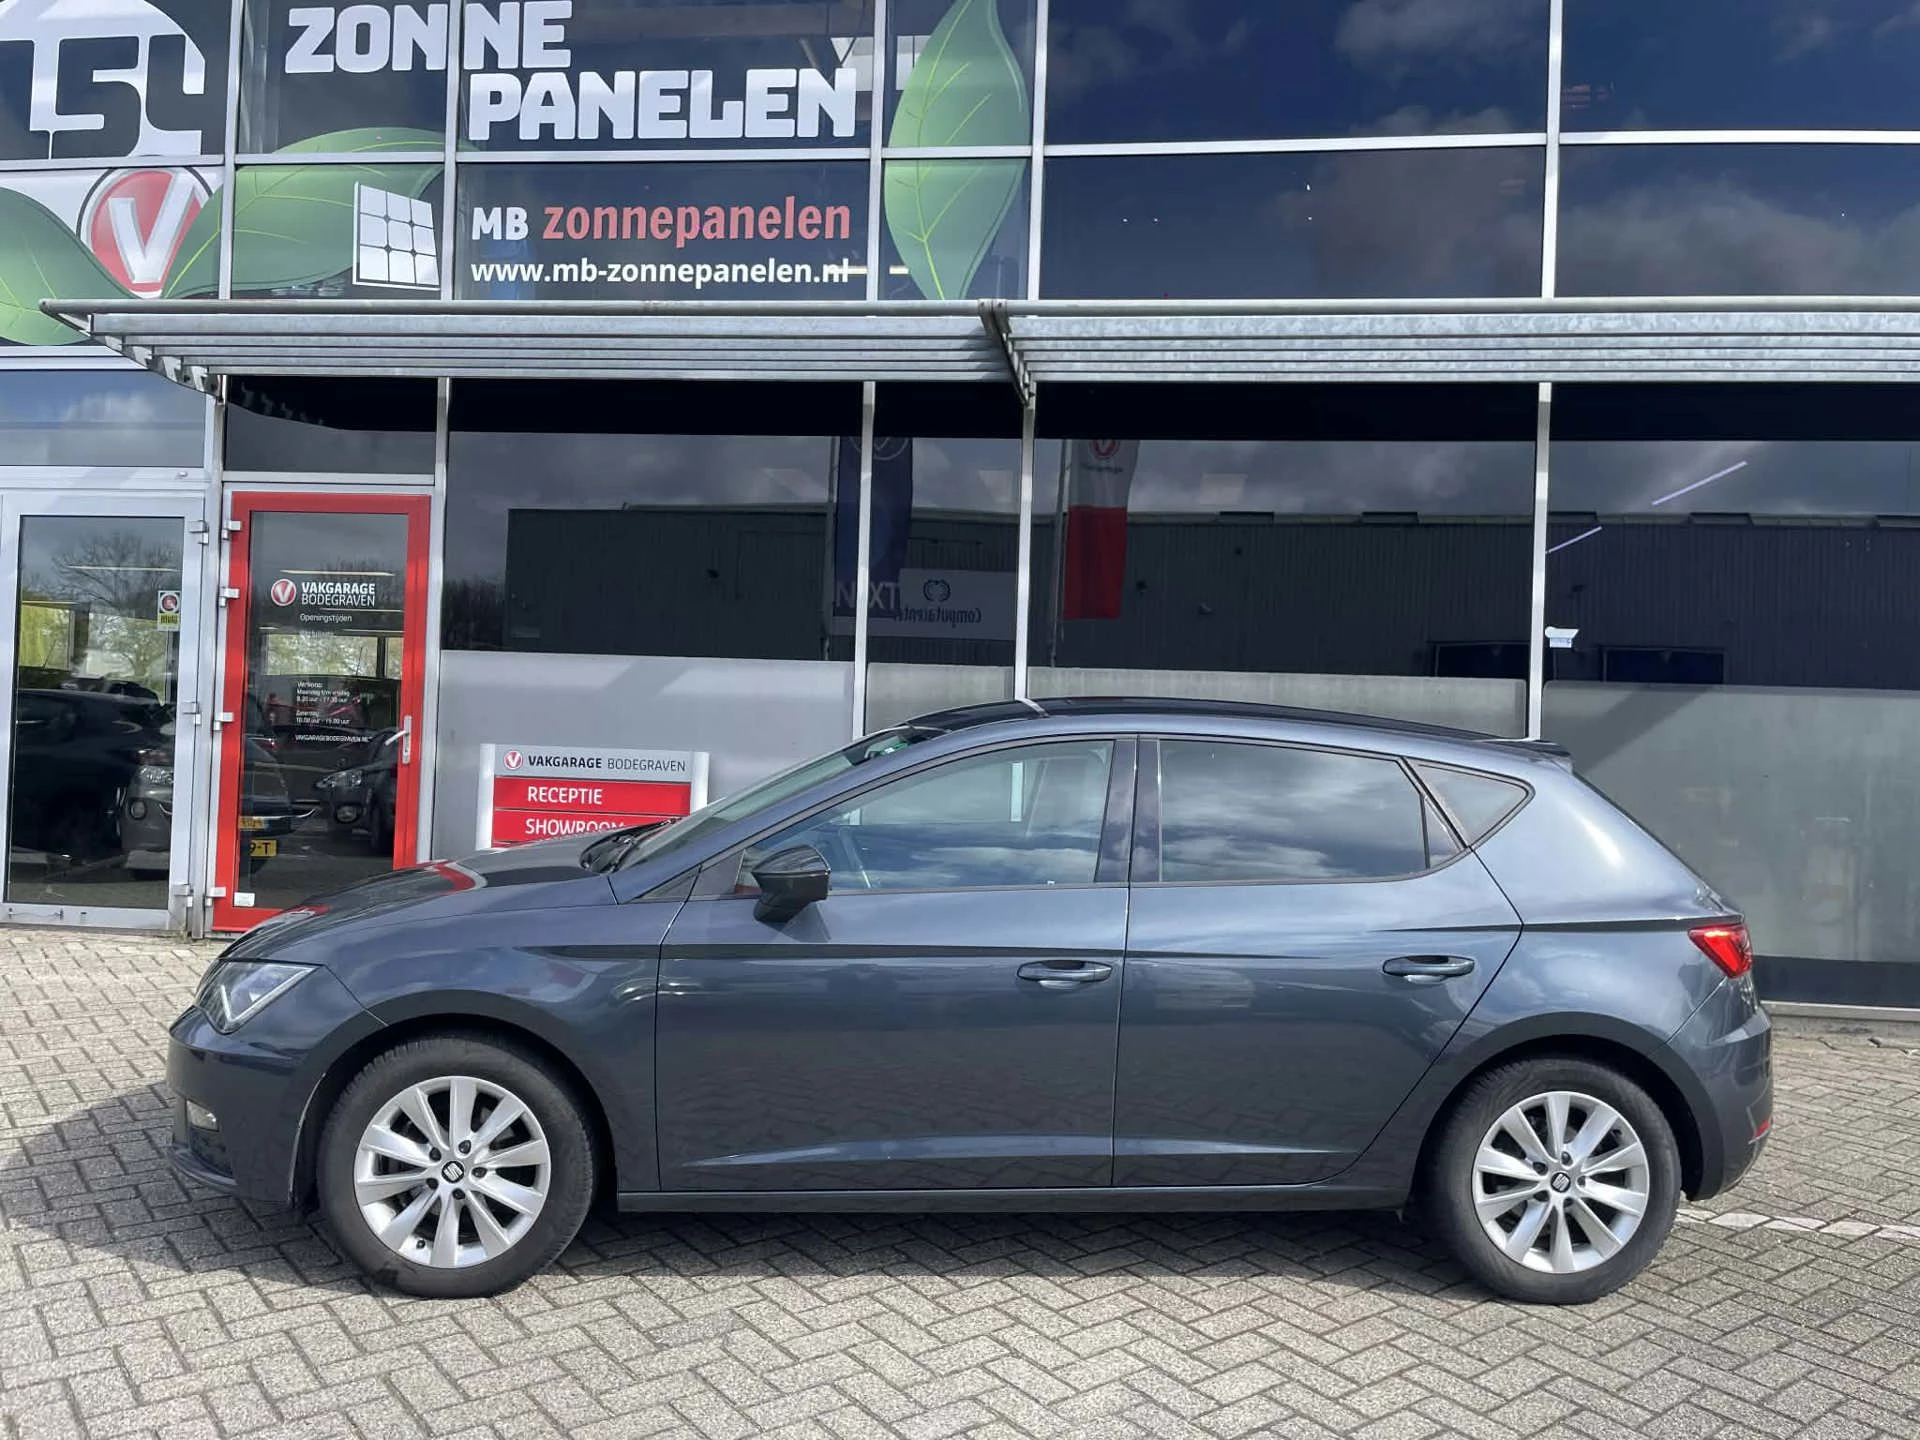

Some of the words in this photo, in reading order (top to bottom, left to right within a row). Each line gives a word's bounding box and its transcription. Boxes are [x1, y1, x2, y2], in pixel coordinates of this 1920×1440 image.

[285, 0, 572, 74] ZONNE
[468, 68, 857, 141] PANELEN
[471, 206, 529, 241] MB
[543, 196, 850, 248] zonnepanelen
[471, 257, 849, 289] www.mb-zonnepanelen.nl
[301, 582, 376, 595] VAKGARAGE
[301, 593, 376, 607] BODEGRAVEN
[835, 580, 898, 610] NXT
[299, 612, 353, 624] Openingstijden
[528, 755, 602, 769] VAKGARAGE
[607, 757, 686, 772] BODEGRAVEN
[527, 786, 603, 805] RECEPTIE
